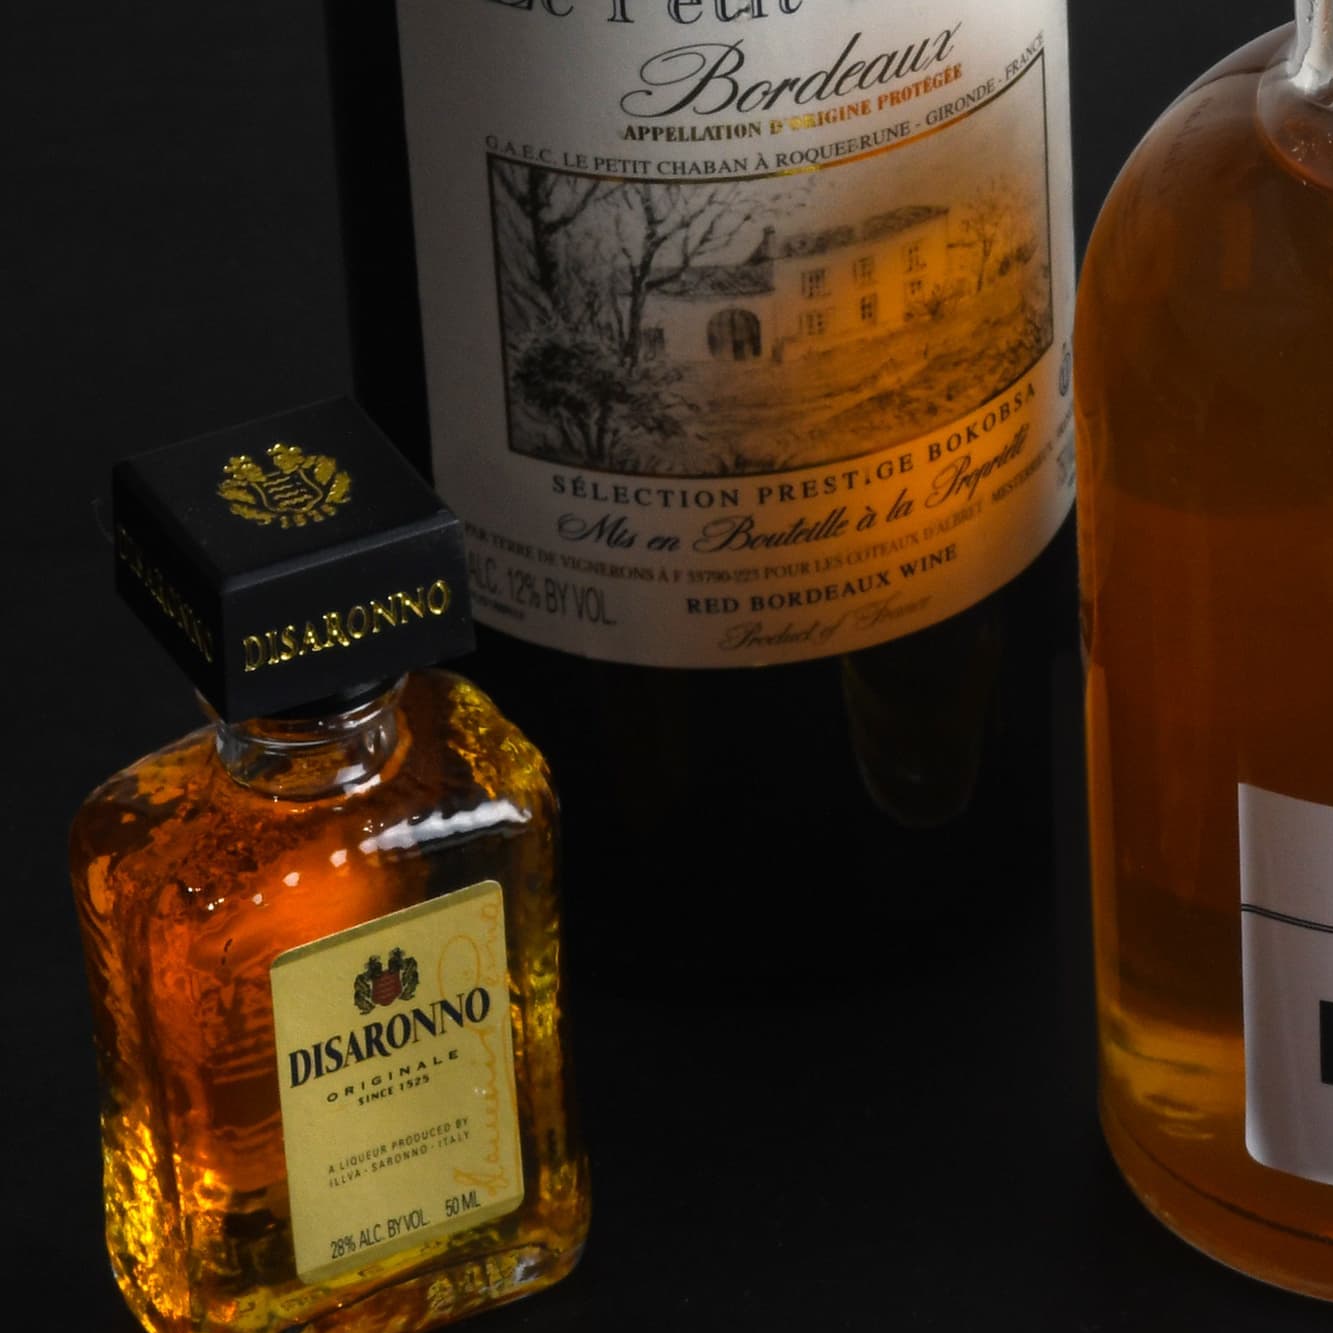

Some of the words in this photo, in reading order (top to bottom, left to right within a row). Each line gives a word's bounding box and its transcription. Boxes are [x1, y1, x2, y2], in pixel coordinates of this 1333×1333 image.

[620, 22, 962, 118] Bordeaux
[622, 121, 761, 143] APPELLATION
[877, 62, 963, 111] PROTÉGÉE
[563, 152, 589, 170] LE
[594, 157, 651, 176] PETIT
[656, 157, 748, 176] CHABAN
[755, 152, 770, 170] À
[925, 78, 995, 126] GIRONDE
[552, 475, 740, 509] SÉLECTION
[928, 382, 1036, 462] BOKOBSA
[557, 511, 640, 550] Mis
[647, 534, 681, 551] en
[856, 505, 877, 533] à
[885, 488, 914, 522] la
[686, 597, 740, 615] RED
[750, 570, 892, 612] BORDEAUX
[899, 543, 958, 580] WINE
[241, 578, 450, 672] DISARONNO
[288, 985, 491, 1090] DISARONNO
[326, 1049, 459, 1103] ORIGINALE
[357, 1085, 394, 1107] SINCE
[400, 1073, 431, 1092] 1525
[328, 1170, 361, 1188] ILLVA
[371, 1144, 428, 1173] SARONNO
[437, 1130, 471, 1149] ITALY
[339, 1144, 388, 1171] LIQUEUR
[391, 1122, 452, 1150] PRODUCED
[455, 1117, 469, 1130] BY
[329, 1234, 357, 1260] 28%
[387, 1216, 402, 1239] BY
[444, 1196, 460, 1218] 50
[461, 1189, 482, 1212] ML
